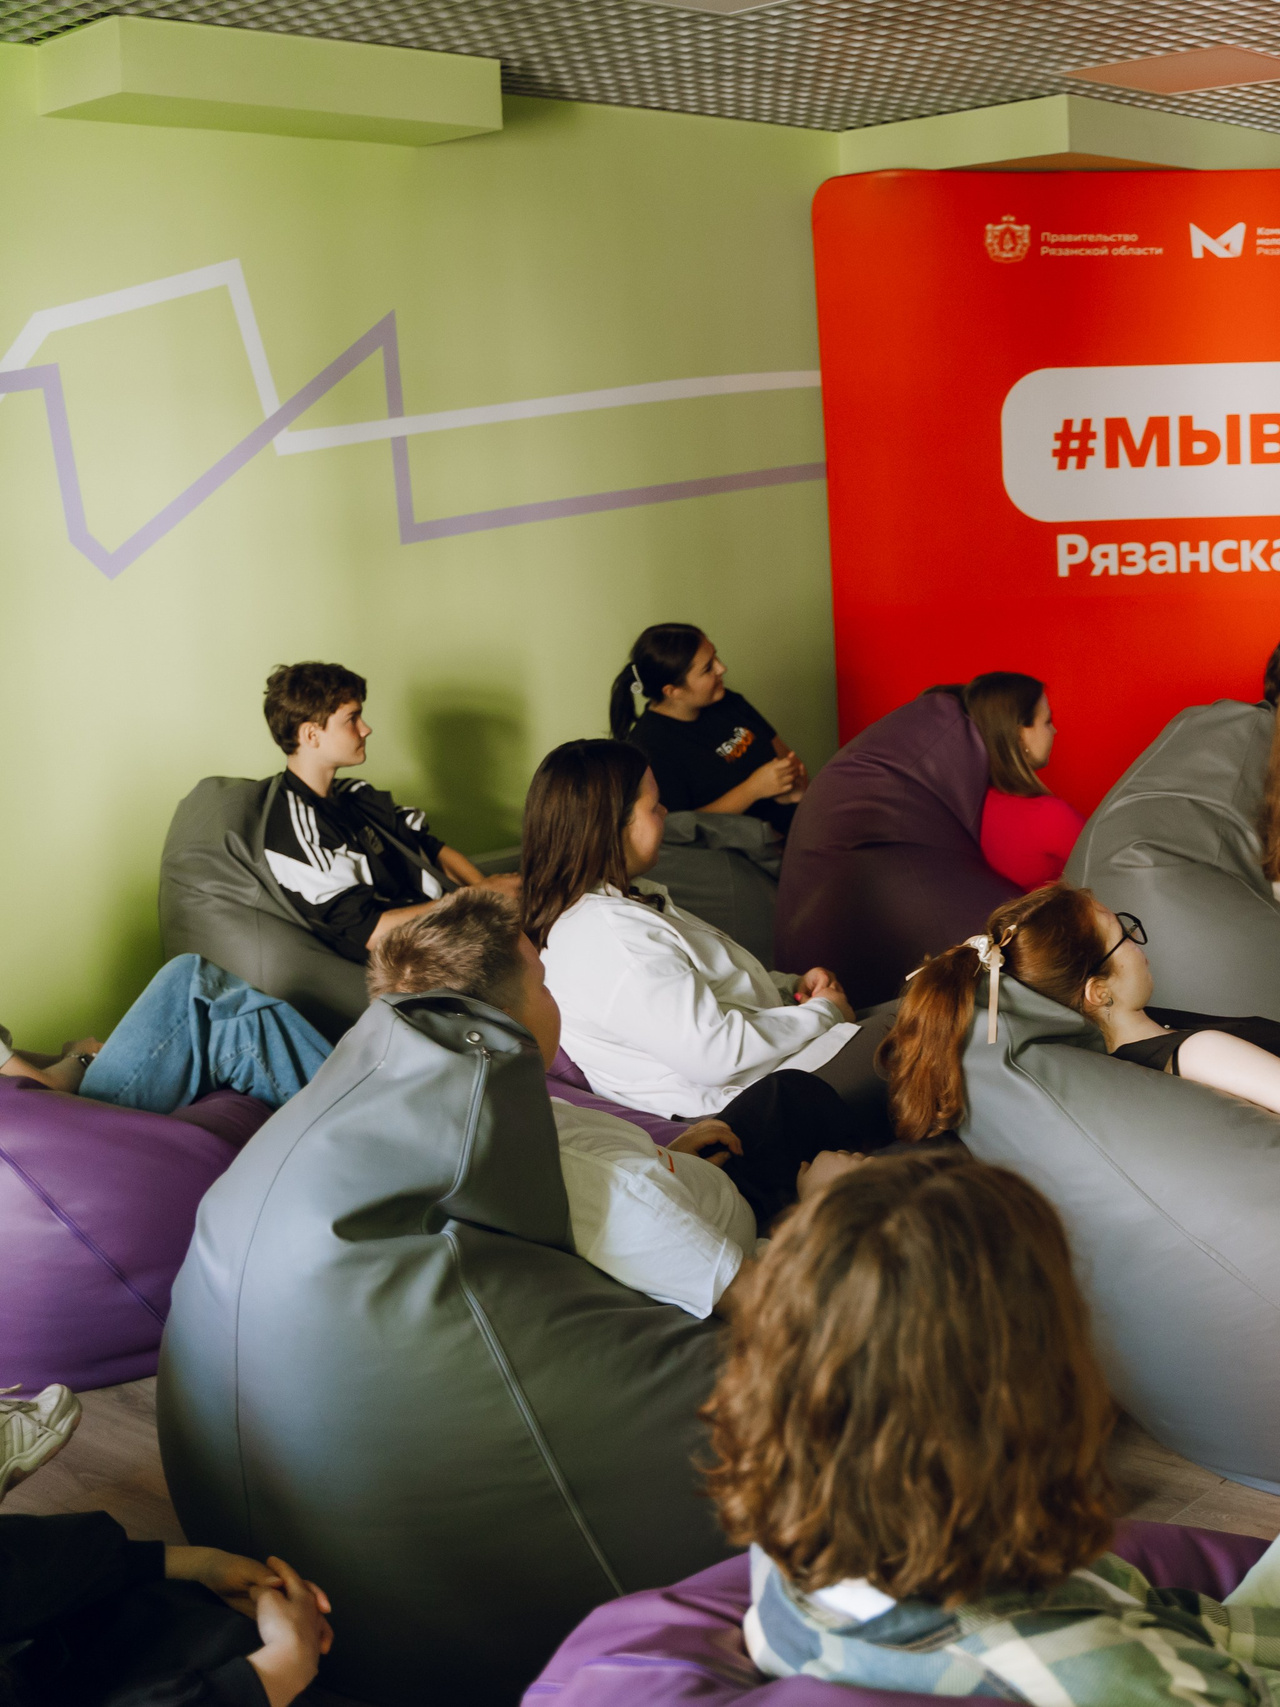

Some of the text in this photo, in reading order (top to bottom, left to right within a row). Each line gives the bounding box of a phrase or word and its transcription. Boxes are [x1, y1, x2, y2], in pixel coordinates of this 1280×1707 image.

[1040, 231, 1138, 244] Правительство
[1040, 245, 1163, 256] Рязанской области
